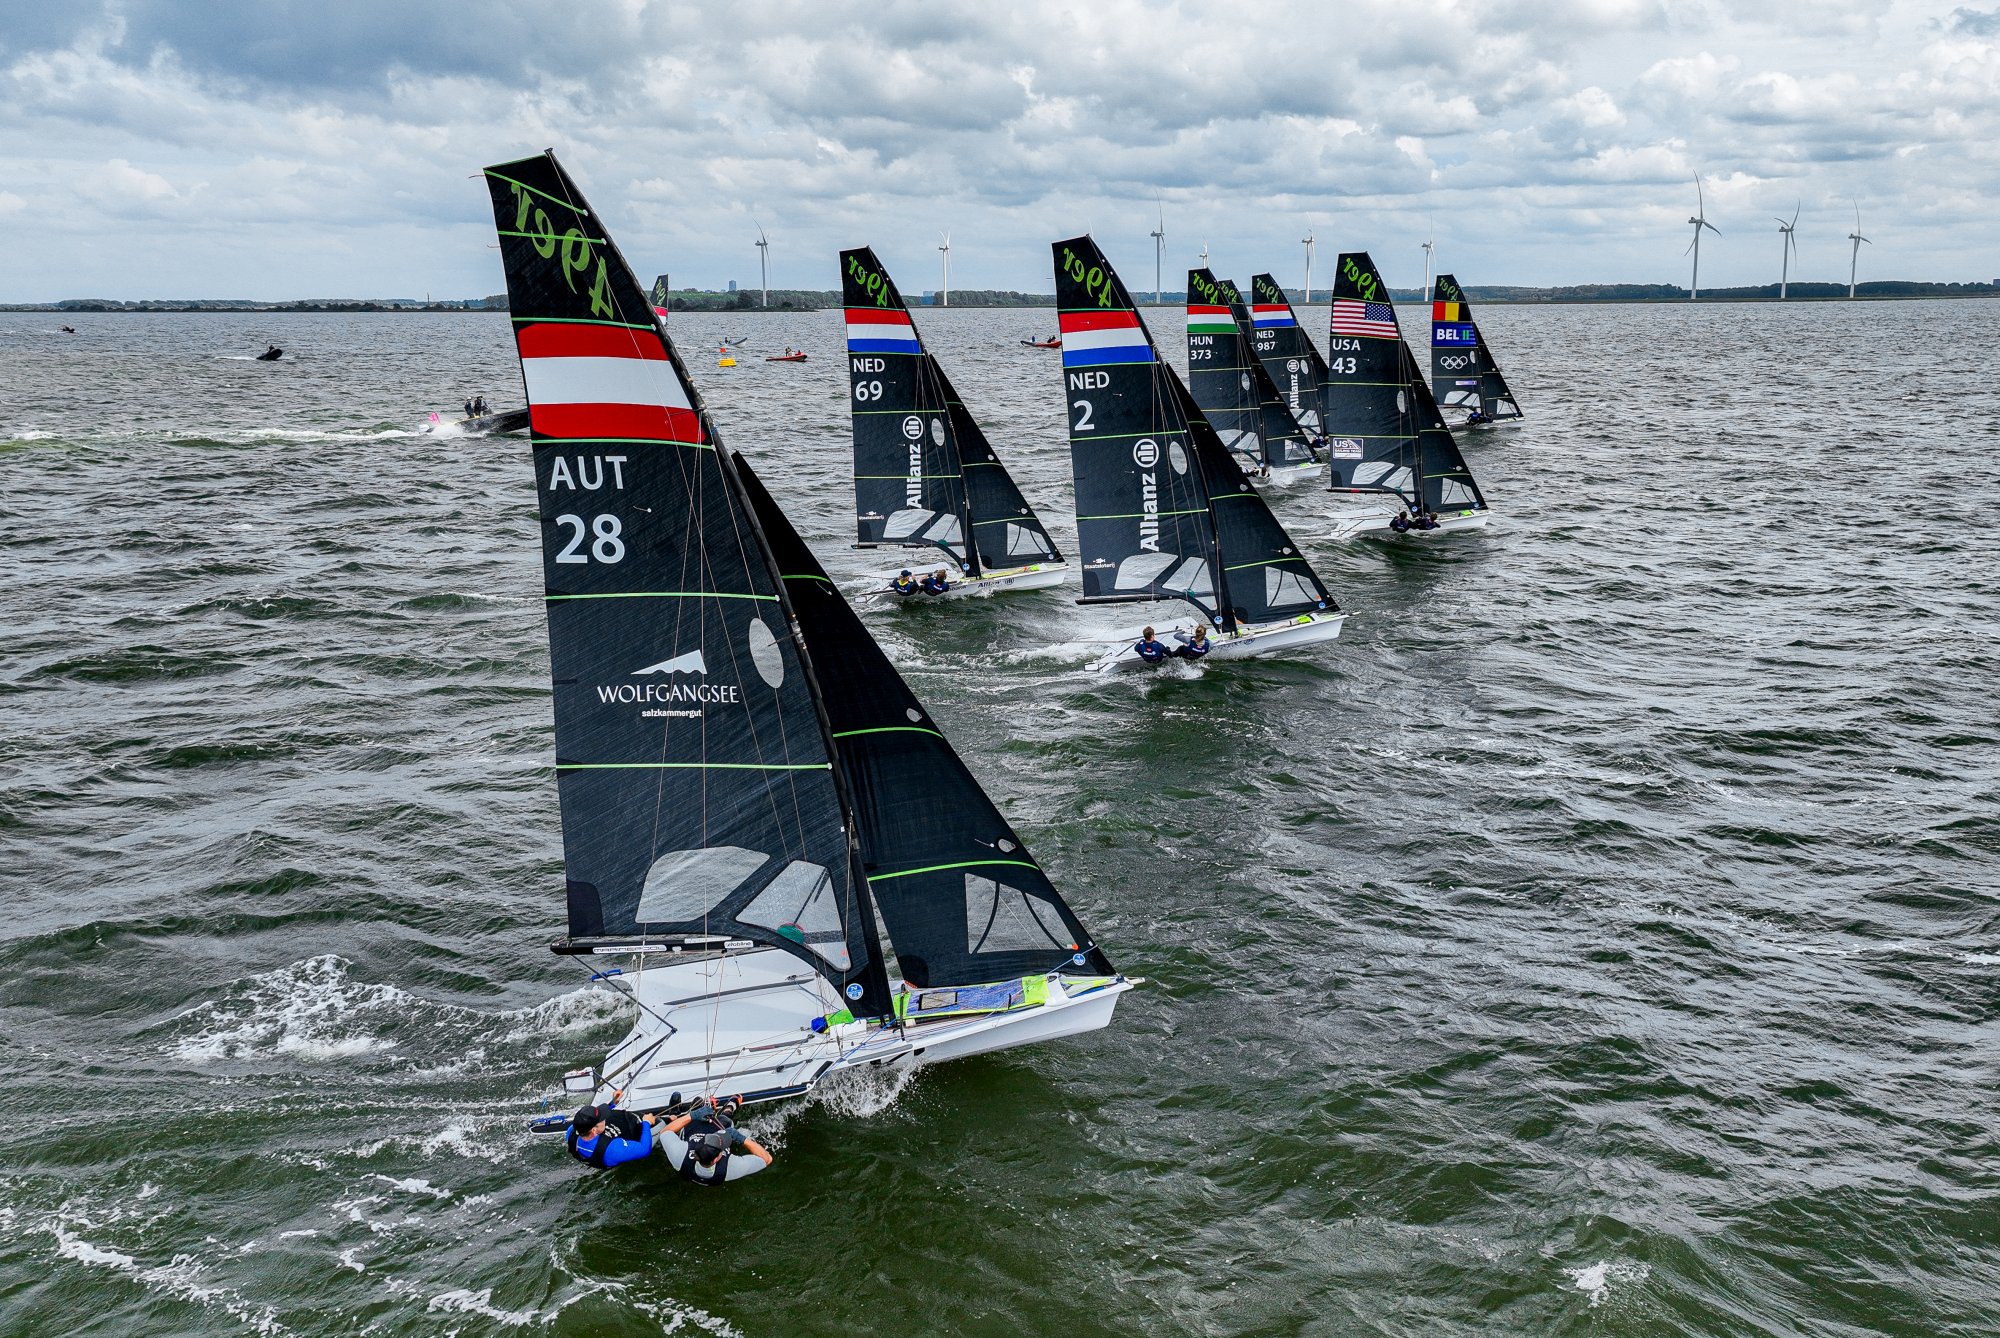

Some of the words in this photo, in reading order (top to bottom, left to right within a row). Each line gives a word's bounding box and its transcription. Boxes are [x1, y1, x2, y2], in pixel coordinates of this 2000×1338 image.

[1190, 336, 1213, 345] HUN
[1256, 330, 1275, 339] NED
[1437, 329, 1460, 340] BEL
[1257, 341, 1276, 351] 987
[1332, 338, 1361, 351] USA
[1190, 350, 1212, 360] 373
[853, 358, 886, 373] NED
[1332, 357, 1357, 374] 43
[1070, 371, 1110, 391] NED
[855, 380, 883, 401] 69
[1289, 374, 1299, 409] Allianz
[1073, 400, 1095, 431] 2
[550, 455, 628, 491] AUT
[906, 443, 922, 509] Allianz
[1140, 472, 1160, 552] Allianz
[555, 513, 626, 564] 28
[597, 684, 739, 703] WOLFGANGSEE
[641, 708, 702, 718] salzkammergut
